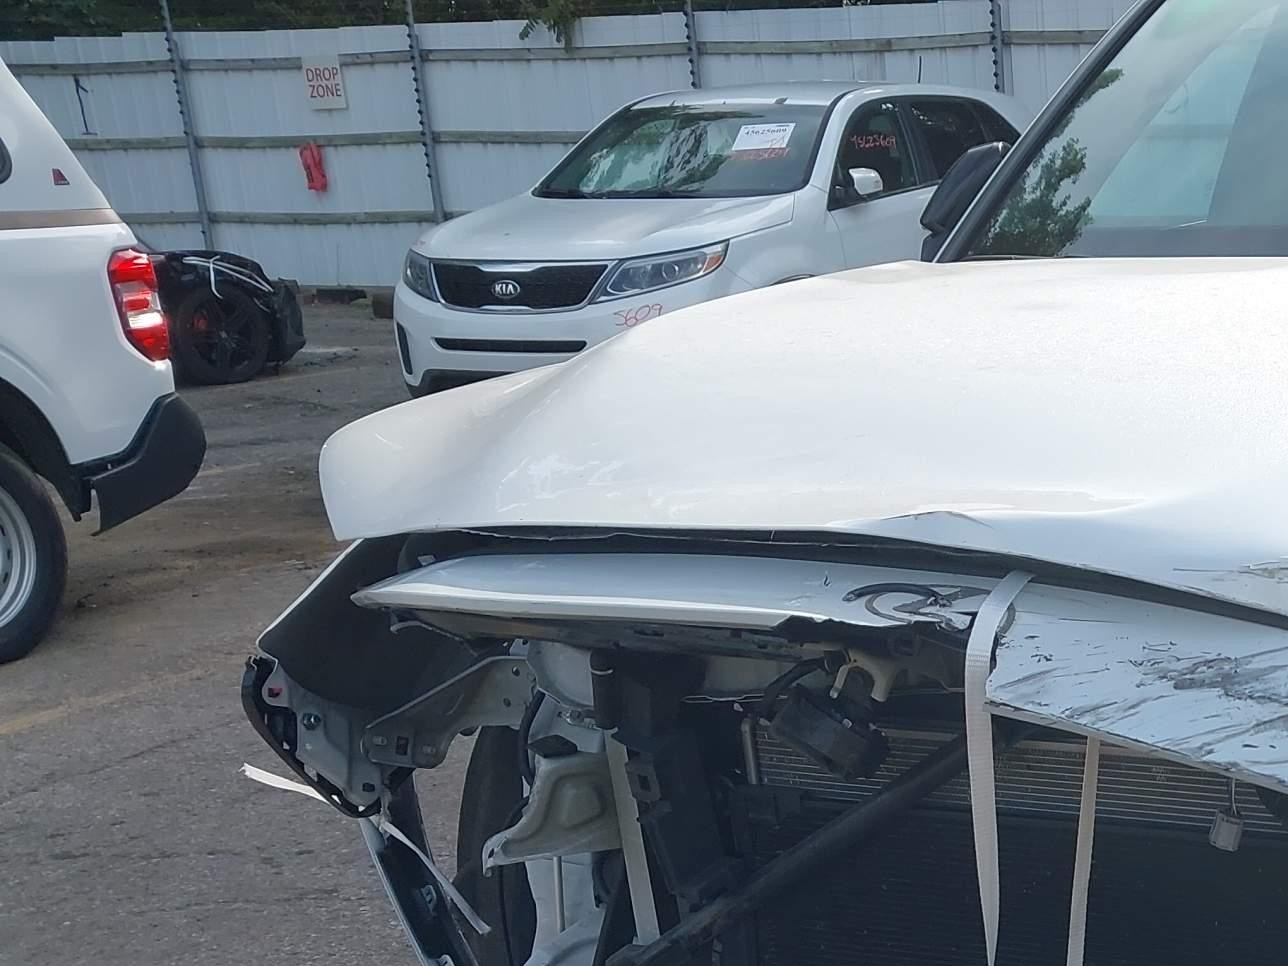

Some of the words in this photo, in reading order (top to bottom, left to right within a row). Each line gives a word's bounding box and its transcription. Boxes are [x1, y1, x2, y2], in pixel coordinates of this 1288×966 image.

[305, 67, 339, 82] DROP
[308, 83, 342, 98] ZONE
[494, 283, 516, 296] KIA
